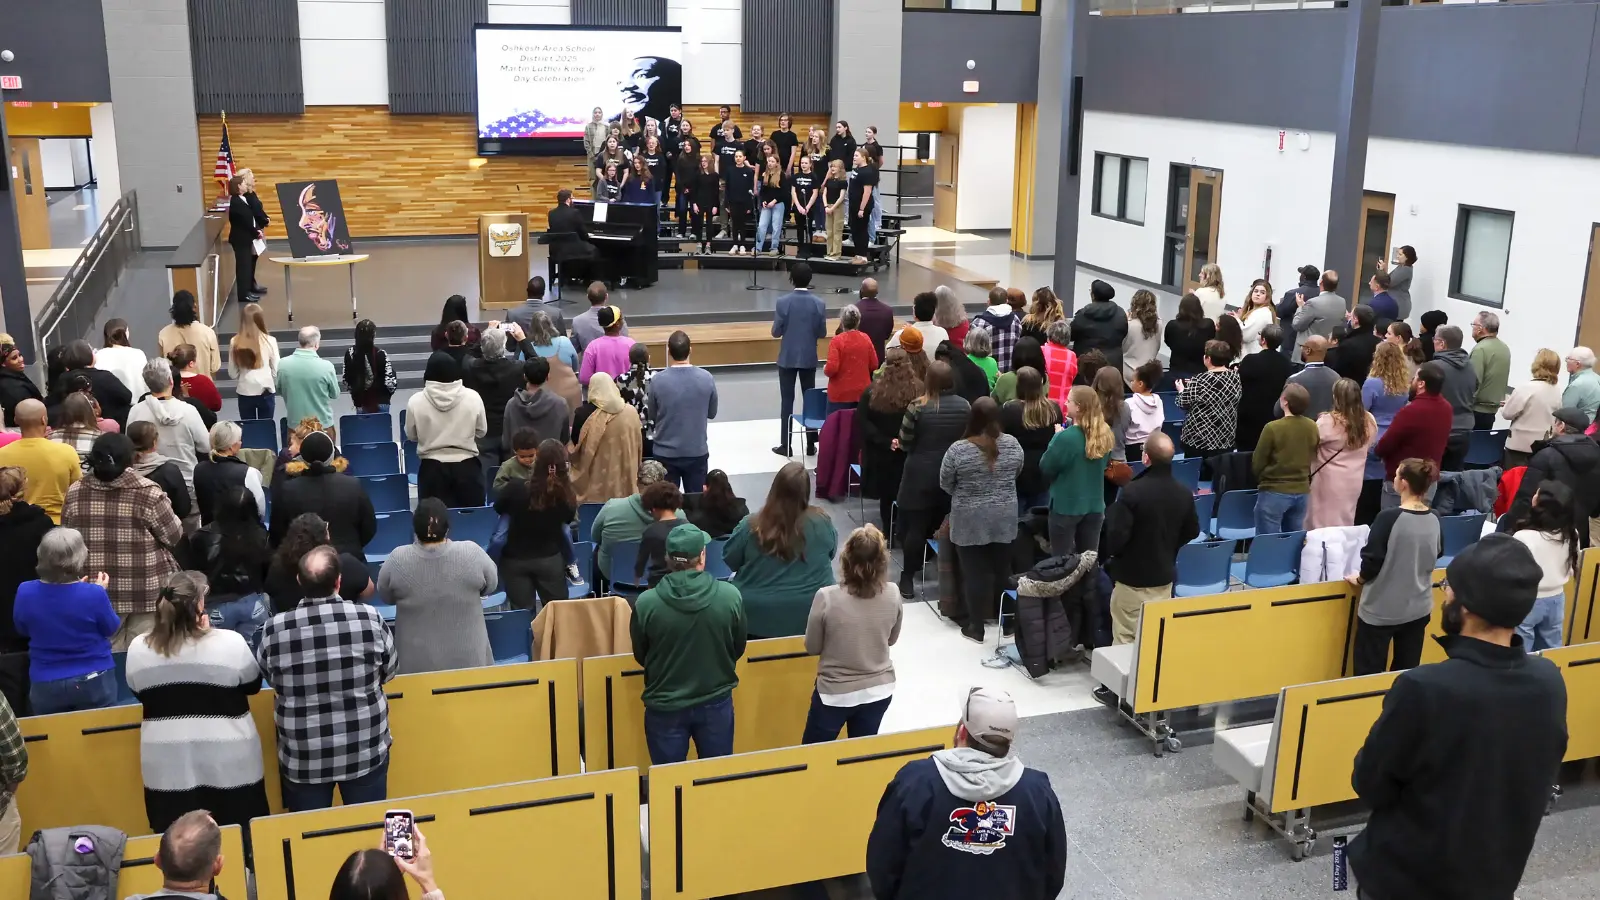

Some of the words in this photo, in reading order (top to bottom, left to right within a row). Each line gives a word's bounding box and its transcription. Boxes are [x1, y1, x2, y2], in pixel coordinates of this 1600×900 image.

[501, 44, 540, 52] Oshkosh
[542, 44, 563, 52] Area
[3, 76, 18, 88] EXIT
[513, 75, 530, 83] Day
